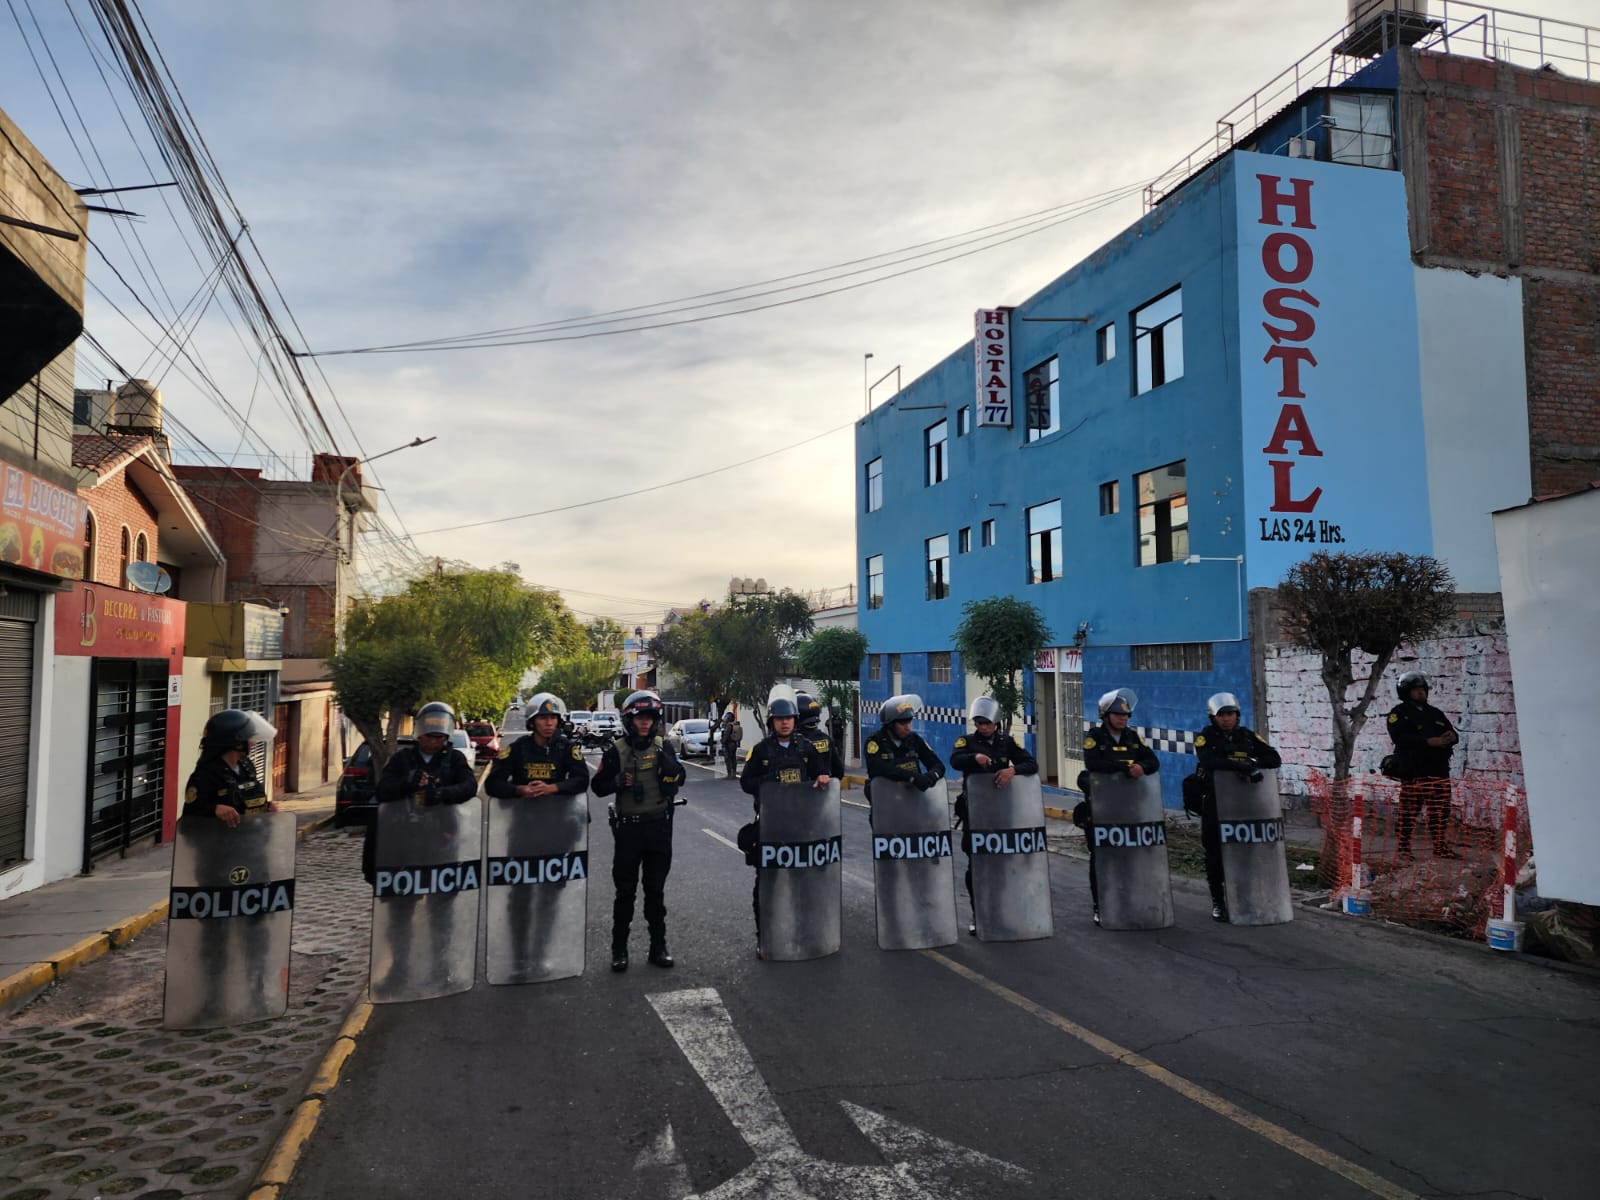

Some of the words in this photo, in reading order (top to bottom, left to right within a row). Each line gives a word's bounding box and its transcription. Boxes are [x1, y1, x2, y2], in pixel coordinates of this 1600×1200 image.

[1256, 174, 1324, 513] HOSTAL
[984, 311, 1007, 404] HOSTAL
[985, 406, 1008, 422] 77
[1259, 518, 1291, 542] LAS
[1293, 518, 1316, 543] 24
[1319, 520, 1346, 543] Hrs.
[231, 869, 247, 882] 37
